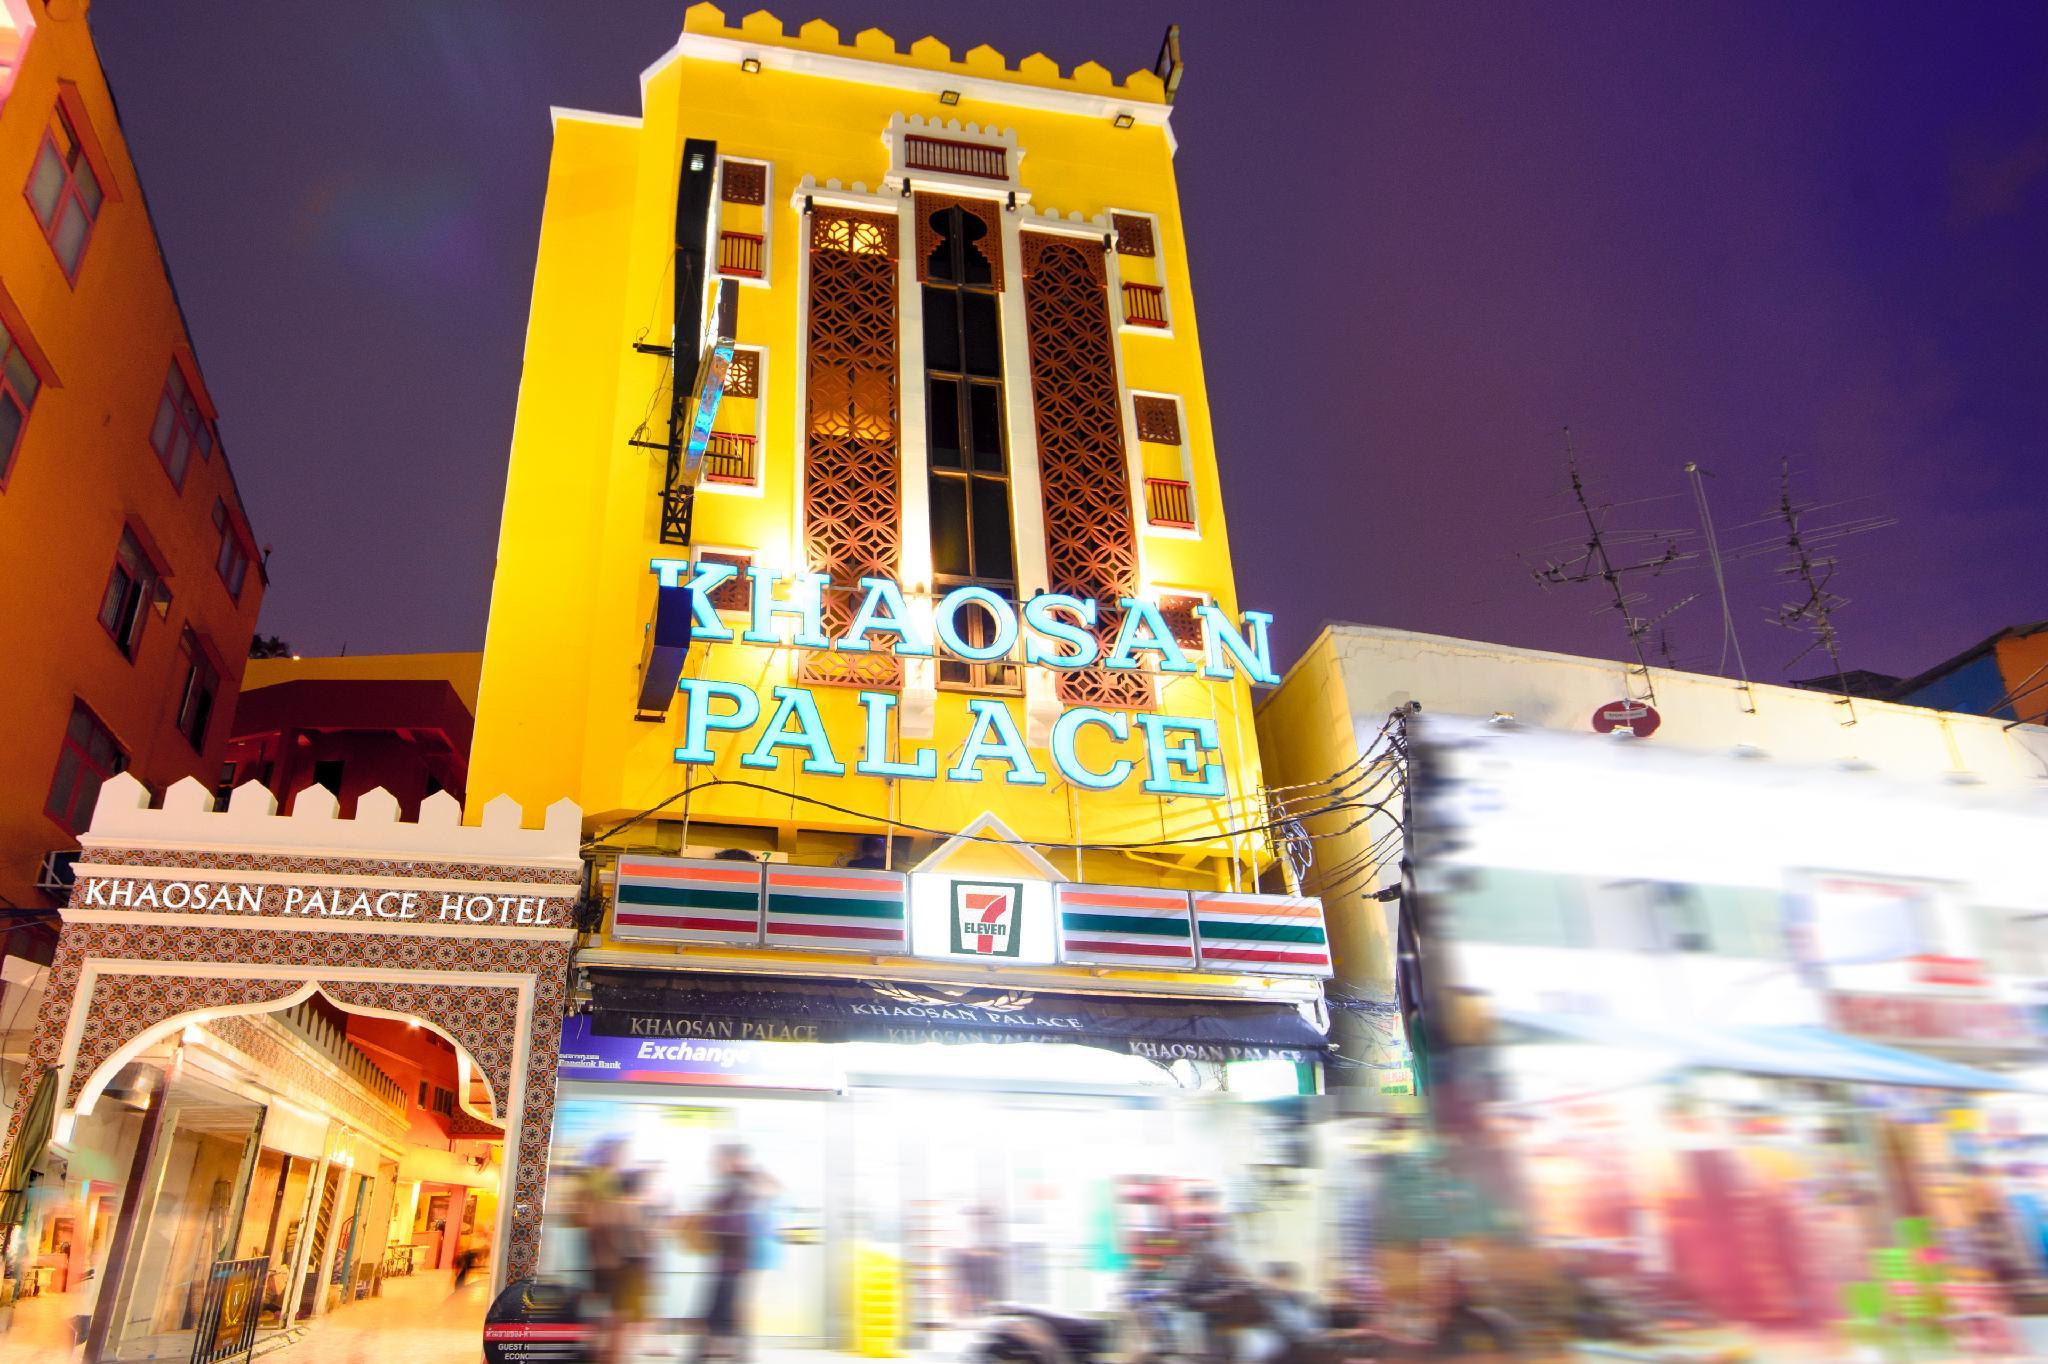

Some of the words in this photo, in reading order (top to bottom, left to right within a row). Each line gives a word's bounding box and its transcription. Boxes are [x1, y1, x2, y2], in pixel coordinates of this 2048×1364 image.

[650, 559, 1280, 686] KHAOSAN
[674, 678, 1226, 798] PALACE
[85, 878, 263, 912] KHAOSAN
[284, 887, 418, 919] PALACE
[438, 894, 551, 926] HOTEL
[965, 893, 1007, 954] 7
[629, 1017, 734, 1038] KHAOSAN
[741, 1022, 818, 1041] PALACE
[850, 1003, 979, 1021] KHAOSAN
[985, 1012, 1084, 1030] PALACE
[1128, 1041, 1226, 1060] KHAOSAN
[598, 1060, 622, 1069] Bank
[497, 1343, 524, 1351] GUEST
